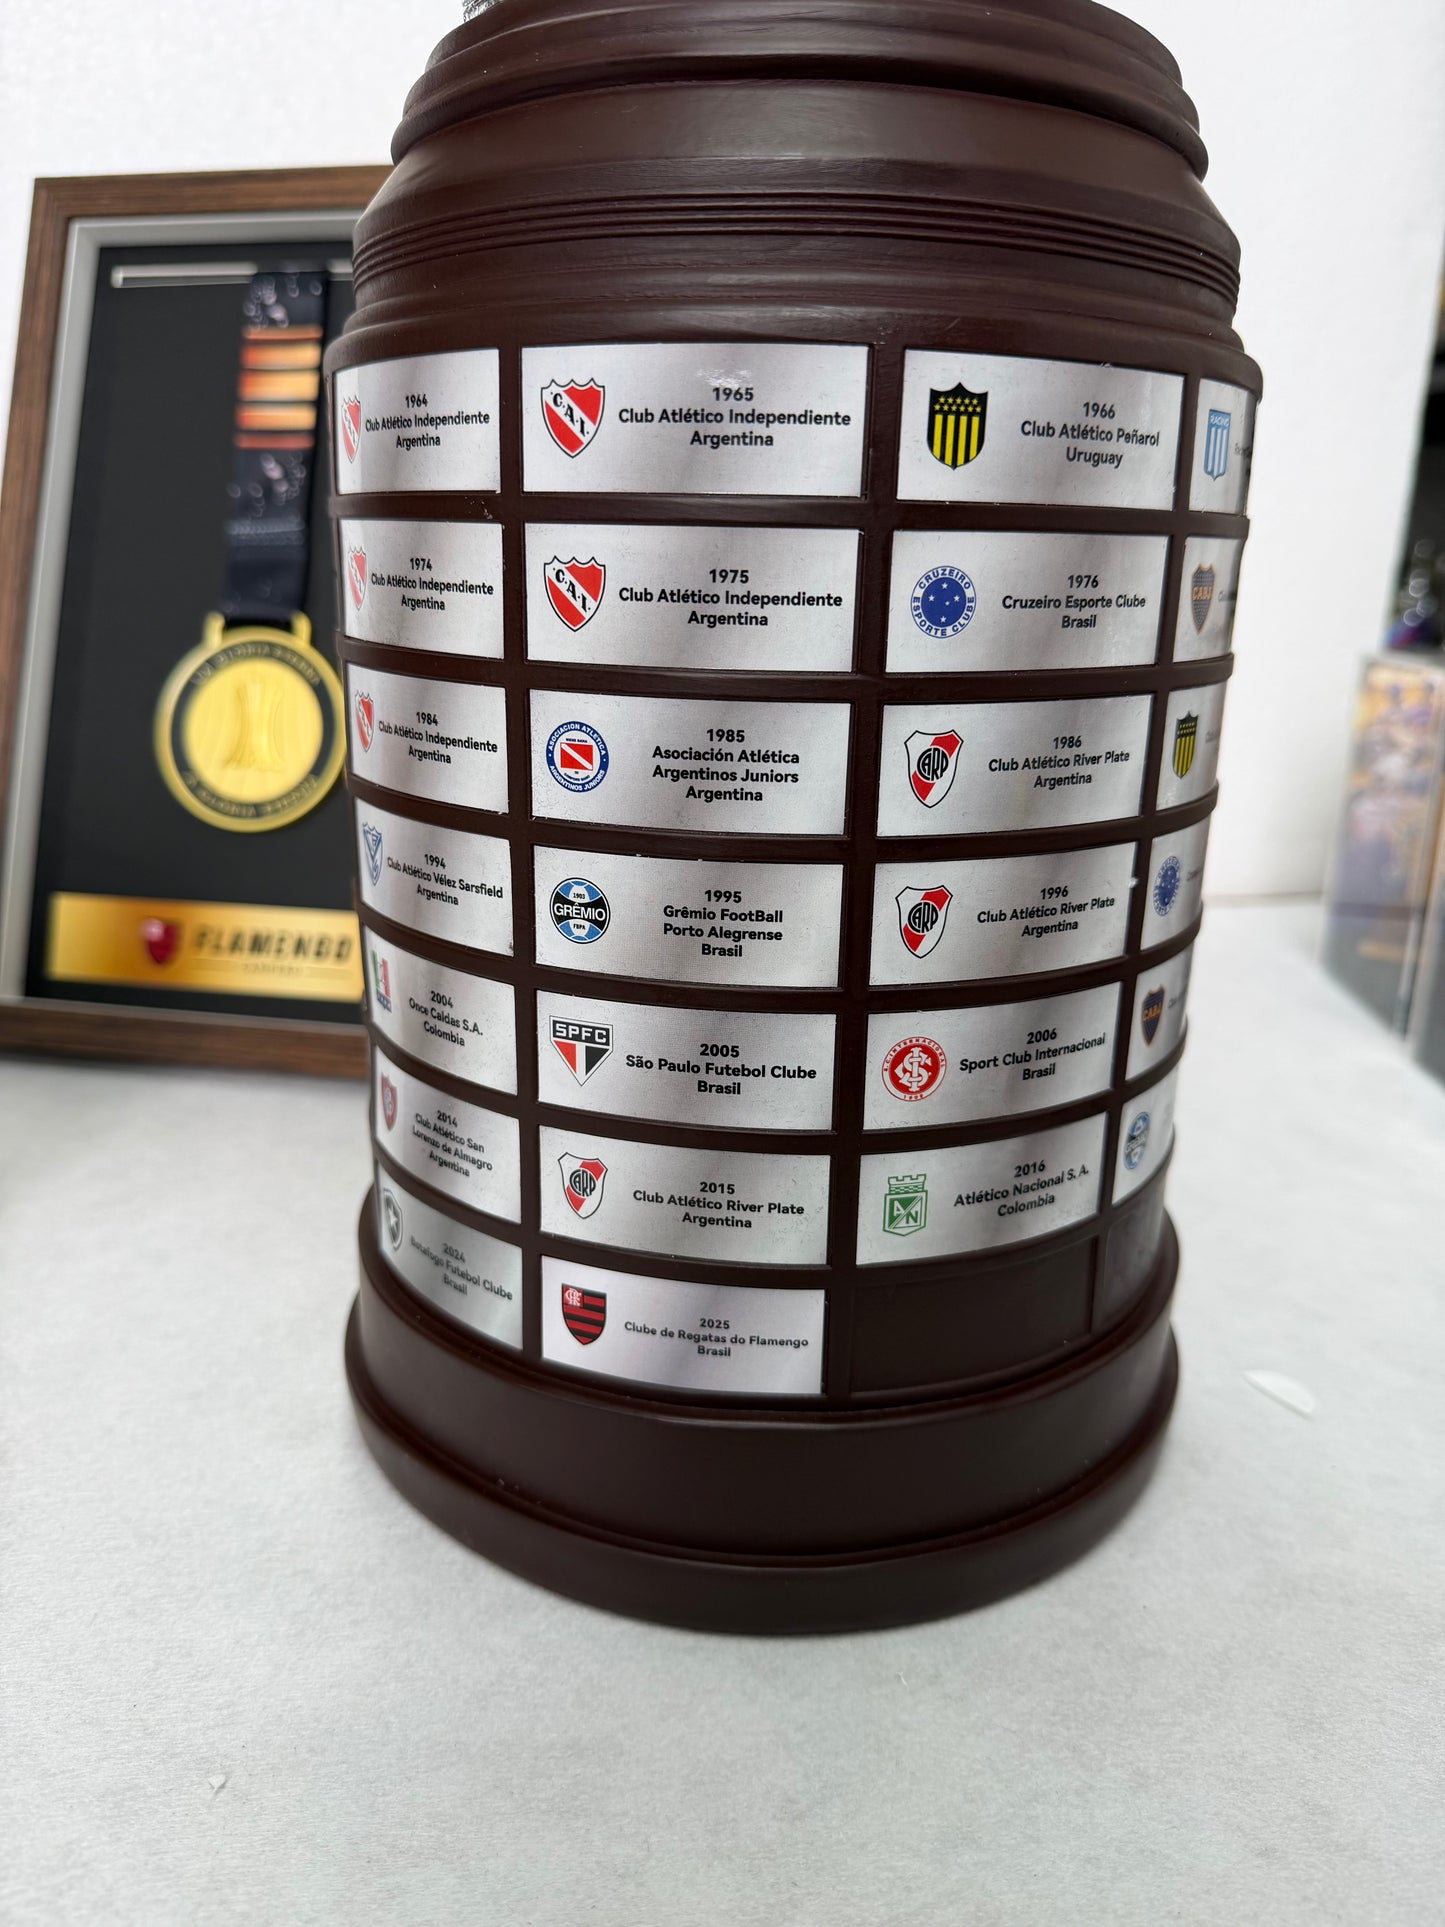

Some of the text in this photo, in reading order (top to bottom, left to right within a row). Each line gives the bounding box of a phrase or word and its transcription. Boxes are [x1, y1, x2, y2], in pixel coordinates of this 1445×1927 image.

[405, 394, 428, 408] 1964
[712, 388, 754, 401] 1965
[618, 409, 851, 425] Club Atlético Independiente
[1083, 402, 1115, 419] 1966
[366, 420, 380, 432] Club
[381, 415, 412, 430] Atlético
[415, 411, 489, 430] Independiente
[396, 433, 441, 450] Argentina
[690, 431, 773, 448] Argentina
[1021, 421, 1160, 446] Club Atlético Peñarol
[1066, 447, 1123, 468] Uruguay
[410, 558, 432, 571] 1974
[371, 573, 385, 585] Club
[387, 575, 417, 589] Atlético
[419, 577, 494, 595] Independiente
[709, 570, 749, 584] 1975
[919, 568, 971, 589] CRUZEIRO
[1068, 575, 1099, 589] 1976
[401, 595, 445, 611] Argentina
[619, 588, 842, 609] Club Atlético Independiente
[1002, 595, 1146, 610] Cruzeiro Esporte Clube
[688, 611, 768, 628] Argentina
[913, 597, 974, 636] ESPORTE CLUBE
[1061, 615, 1097, 628] Brasil
[416, 712, 438, 726] 1984
[379, 721, 498, 752] Club Atlético Independiente
[549, 724, 580, 751] ASOCIACION
[706, 729, 745, 742] 1985
[1053, 735, 1082, 749] 1986
[408, 745, 451, 763] Argentina
[652, 746, 800, 764] Asociación Atlética
[989, 751, 1130, 772] Club Atlético River Plate
[652, 765, 799, 783] Argentinos Juniors
[1034, 773, 1092, 790] Argentina
[686, 786, 763, 802] Argentina
[424, 854, 446, 869] 1994
[387, 857, 503, 898] Club Atlético Vélez Sarsfield
[417, 884, 459, 906] Argentina
[705, 890, 742, 903] 1995
[1040, 886, 1068, 900] 1996
[554, 902, 606, 921] GRÊMIO
[664, 905, 783, 922] Grêmio FootBall
[977, 896, 1115, 923] Club Atlético River Plate
[664, 924, 783, 942] Porto Alegrense
[1022, 921, 1078, 938] Argentina
[701, 944, 742, 957] Brasil
[430, 990, 454, 1008] 2004
[409, 998, 429, 1015] Once
[430, 1009, 460, 1028] Caldas
[462, 1019, 483, 1036] S.A.
[424, 1021, 465, 1047] Colombia
[556, 1023, 607, 1044] SPFC
[1027, 1028, 1057, 1045] 2006
[700, 1044, 740, 1057] 2005
[959, 1033, 1106, 1073] Sport Club Internacional
[626, 1054, 817, 1079] São Paulo Futebol Clube
[1022, 1064, 1055, 1080] Brasil
[697, 1080, 741, 1095] Brasil
[437, 1110, 458, 1127] 2014
[415, 1113, 485, 1153] Club Atlético San
[412, 1125, 493, 1171] Lorenzo de Almagro
[429, 1151, 470, 1177] Argentina
[1014, 1160, 1045, 1178] 2016
[700, 1182, 735, 1194] 2015
[954, 1165, 1089, 1207] Atlético Nacional S. A.
[633, 1190, 805, 1215] Club Atlético River Plate
[997, 1194, 1055, 1217] Colombia
[682, 1213, 752, 1229] Argentina
[443, 1243, 466, 1263] 2024
[443, 1273, 468, 1295] Brasil
[446, 1260, 481, 1286] Futebol
[483, 1279, 513, 1300] Clube
[700, 1318, 730, 1329] 2025
[624, 1321, 809, 1348] Clube de Regatas do Flamengo
[697, 1345, 731, 1356] Brasil
